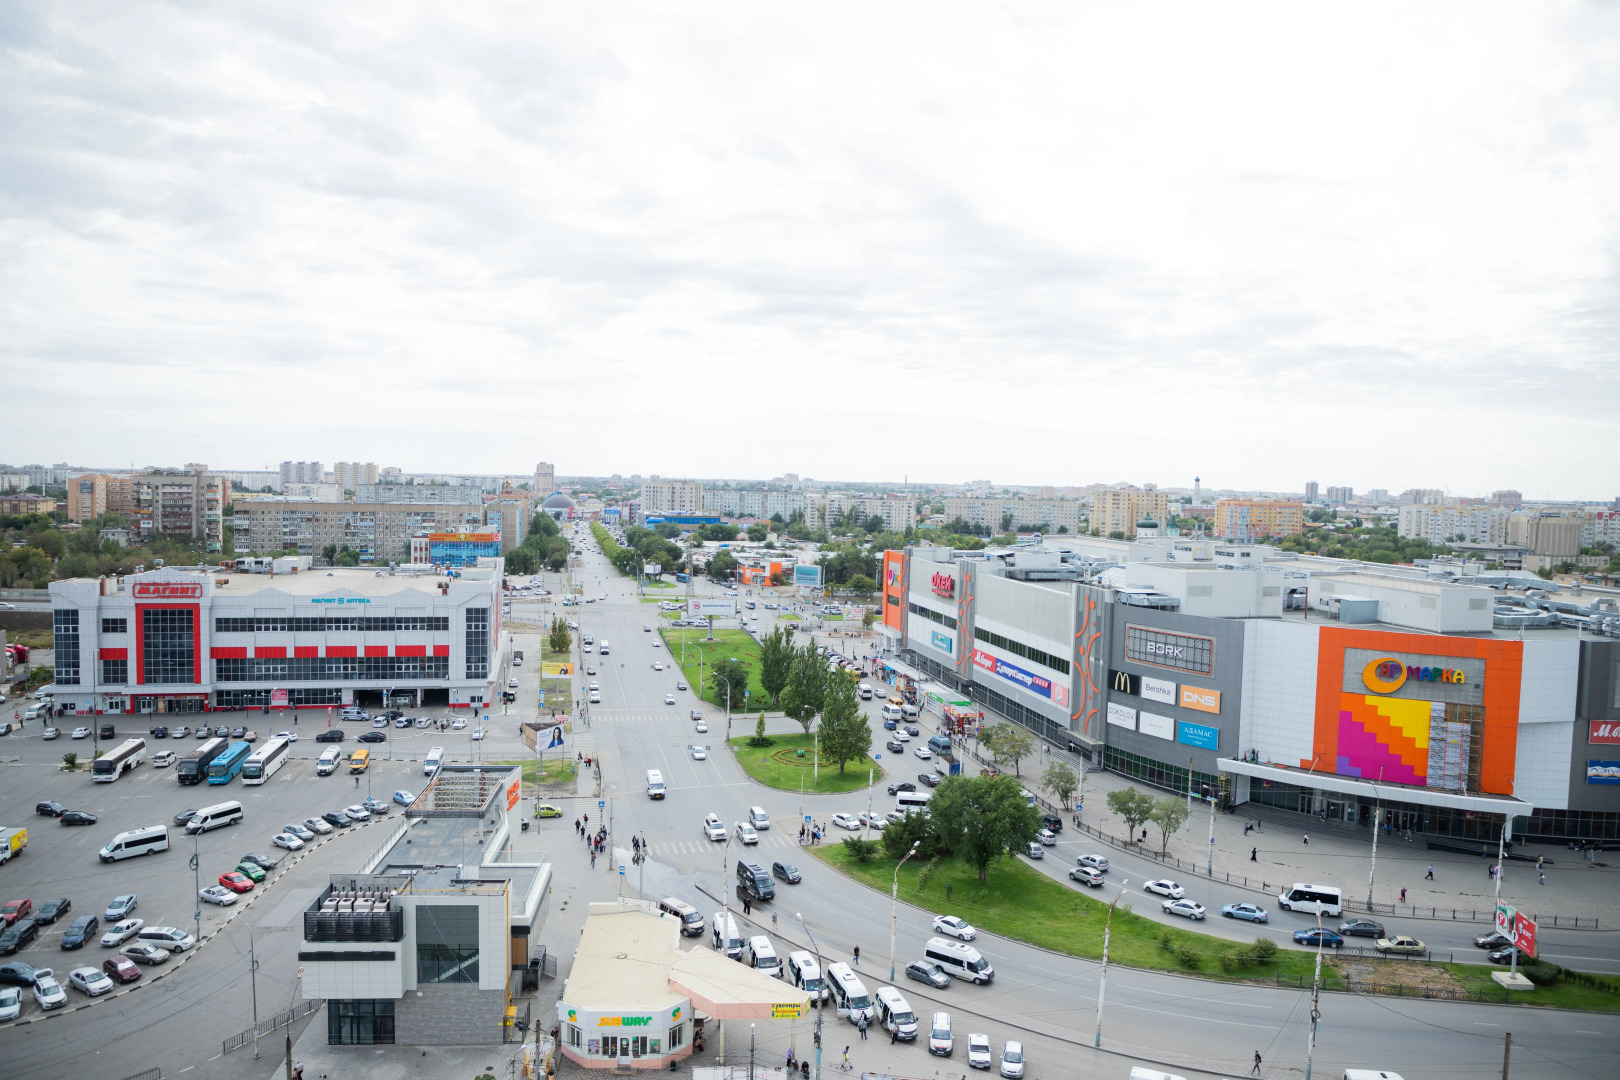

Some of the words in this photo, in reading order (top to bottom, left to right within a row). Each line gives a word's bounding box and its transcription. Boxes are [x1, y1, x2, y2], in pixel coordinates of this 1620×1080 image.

[136, 586, 198, 595] МАГНИТ
[1147, 642, 1183, 658] BORK
[1145, 684, 1170, 696] Bershka
[1184, 692, 1216, 706] DNS
[1109, 706, 1134, 719] SOKOLOV
[1184, 727, 1213, 737] АДАМАС
[597, 1016, 653, 1027] SUBWAY
